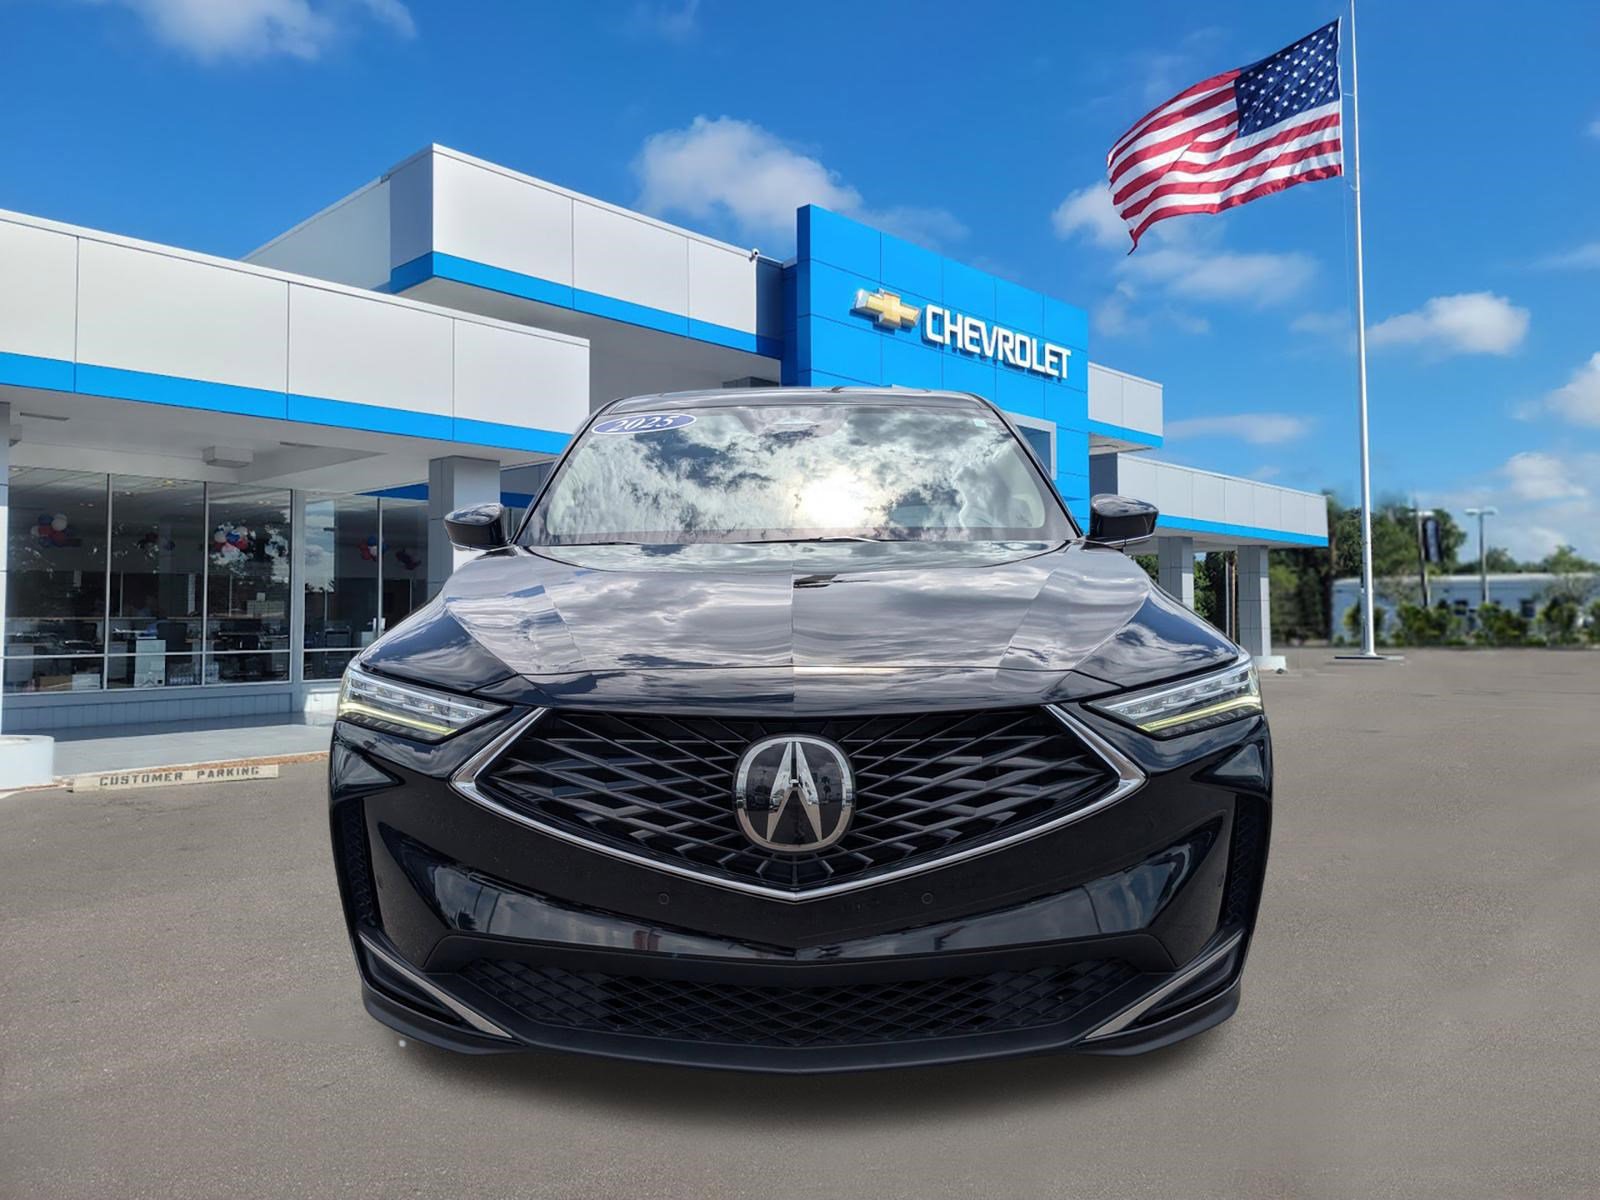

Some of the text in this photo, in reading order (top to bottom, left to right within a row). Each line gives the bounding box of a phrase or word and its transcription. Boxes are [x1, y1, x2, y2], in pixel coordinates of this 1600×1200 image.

[924, 304, 1072, 379] CHEVROLET
[606, 415, 680, 432] 2025
[99, 766, 259, 786] CUSTOMER PARKING
